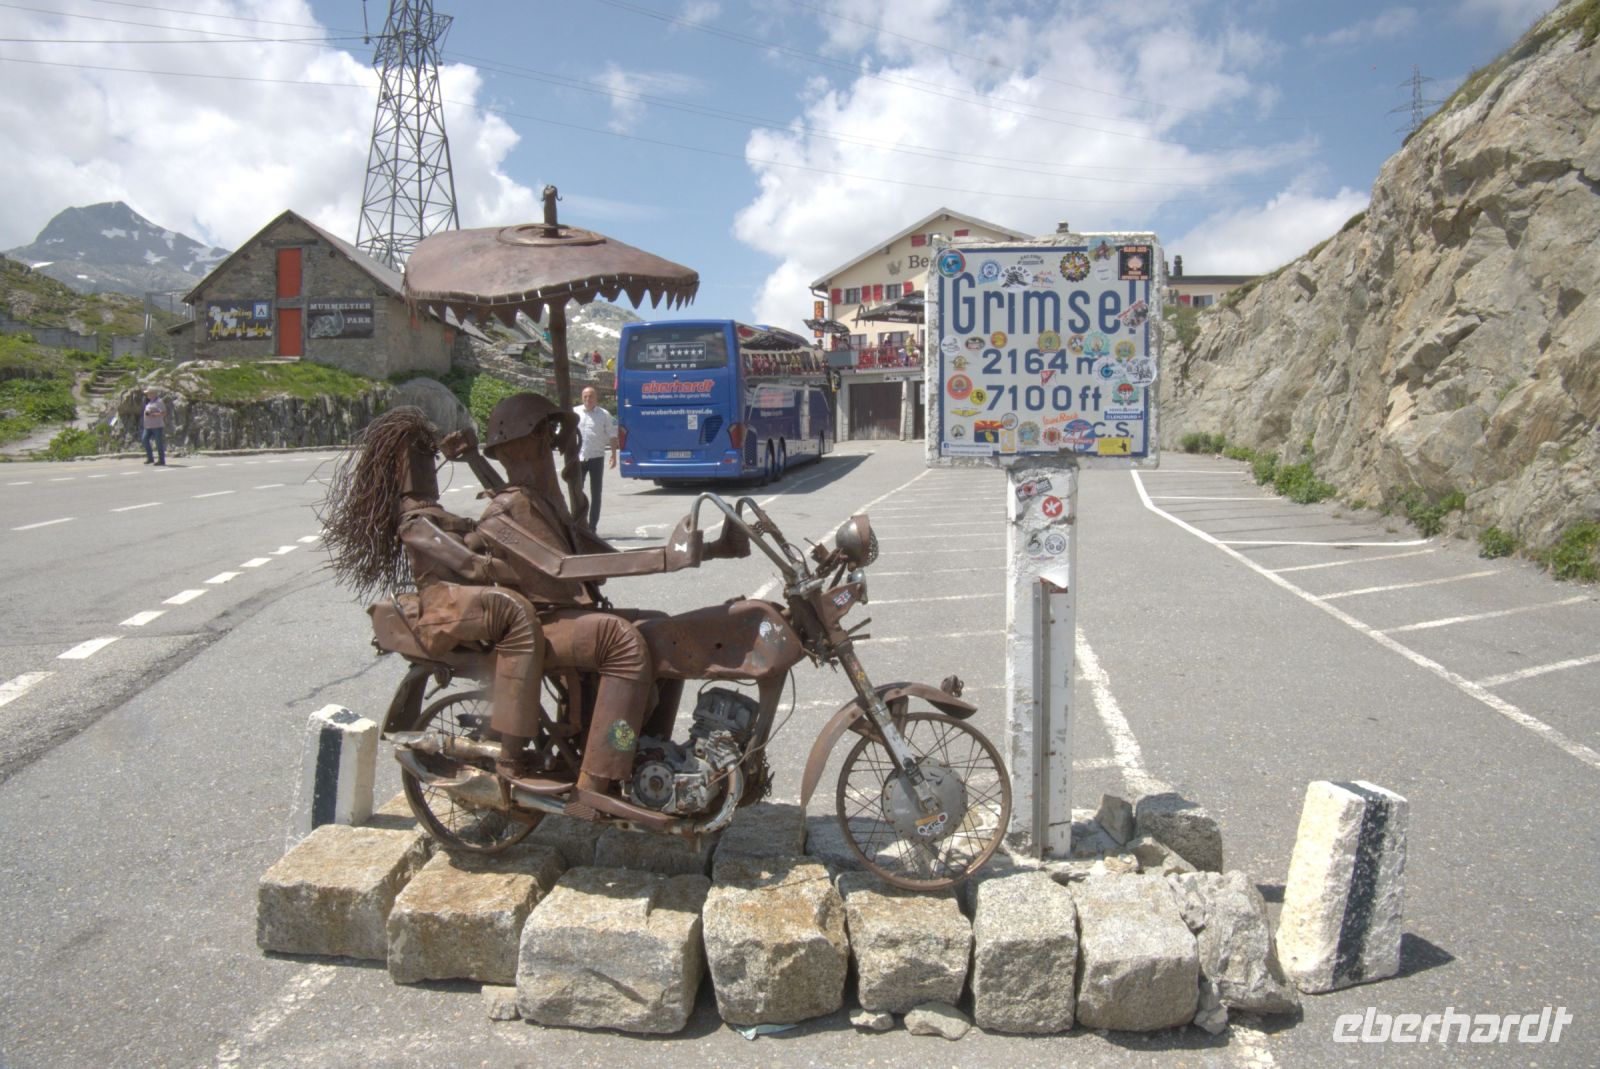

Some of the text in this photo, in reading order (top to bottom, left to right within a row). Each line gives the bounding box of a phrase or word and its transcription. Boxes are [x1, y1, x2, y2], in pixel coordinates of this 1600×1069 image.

[982, 348, 1069, 375] 2164
[641, 380, 715, 393] eberhardt
[986, 384, 1102, 411] 7100 ft
[641, 408, 713, 416] www.eberhardt-travel.de
